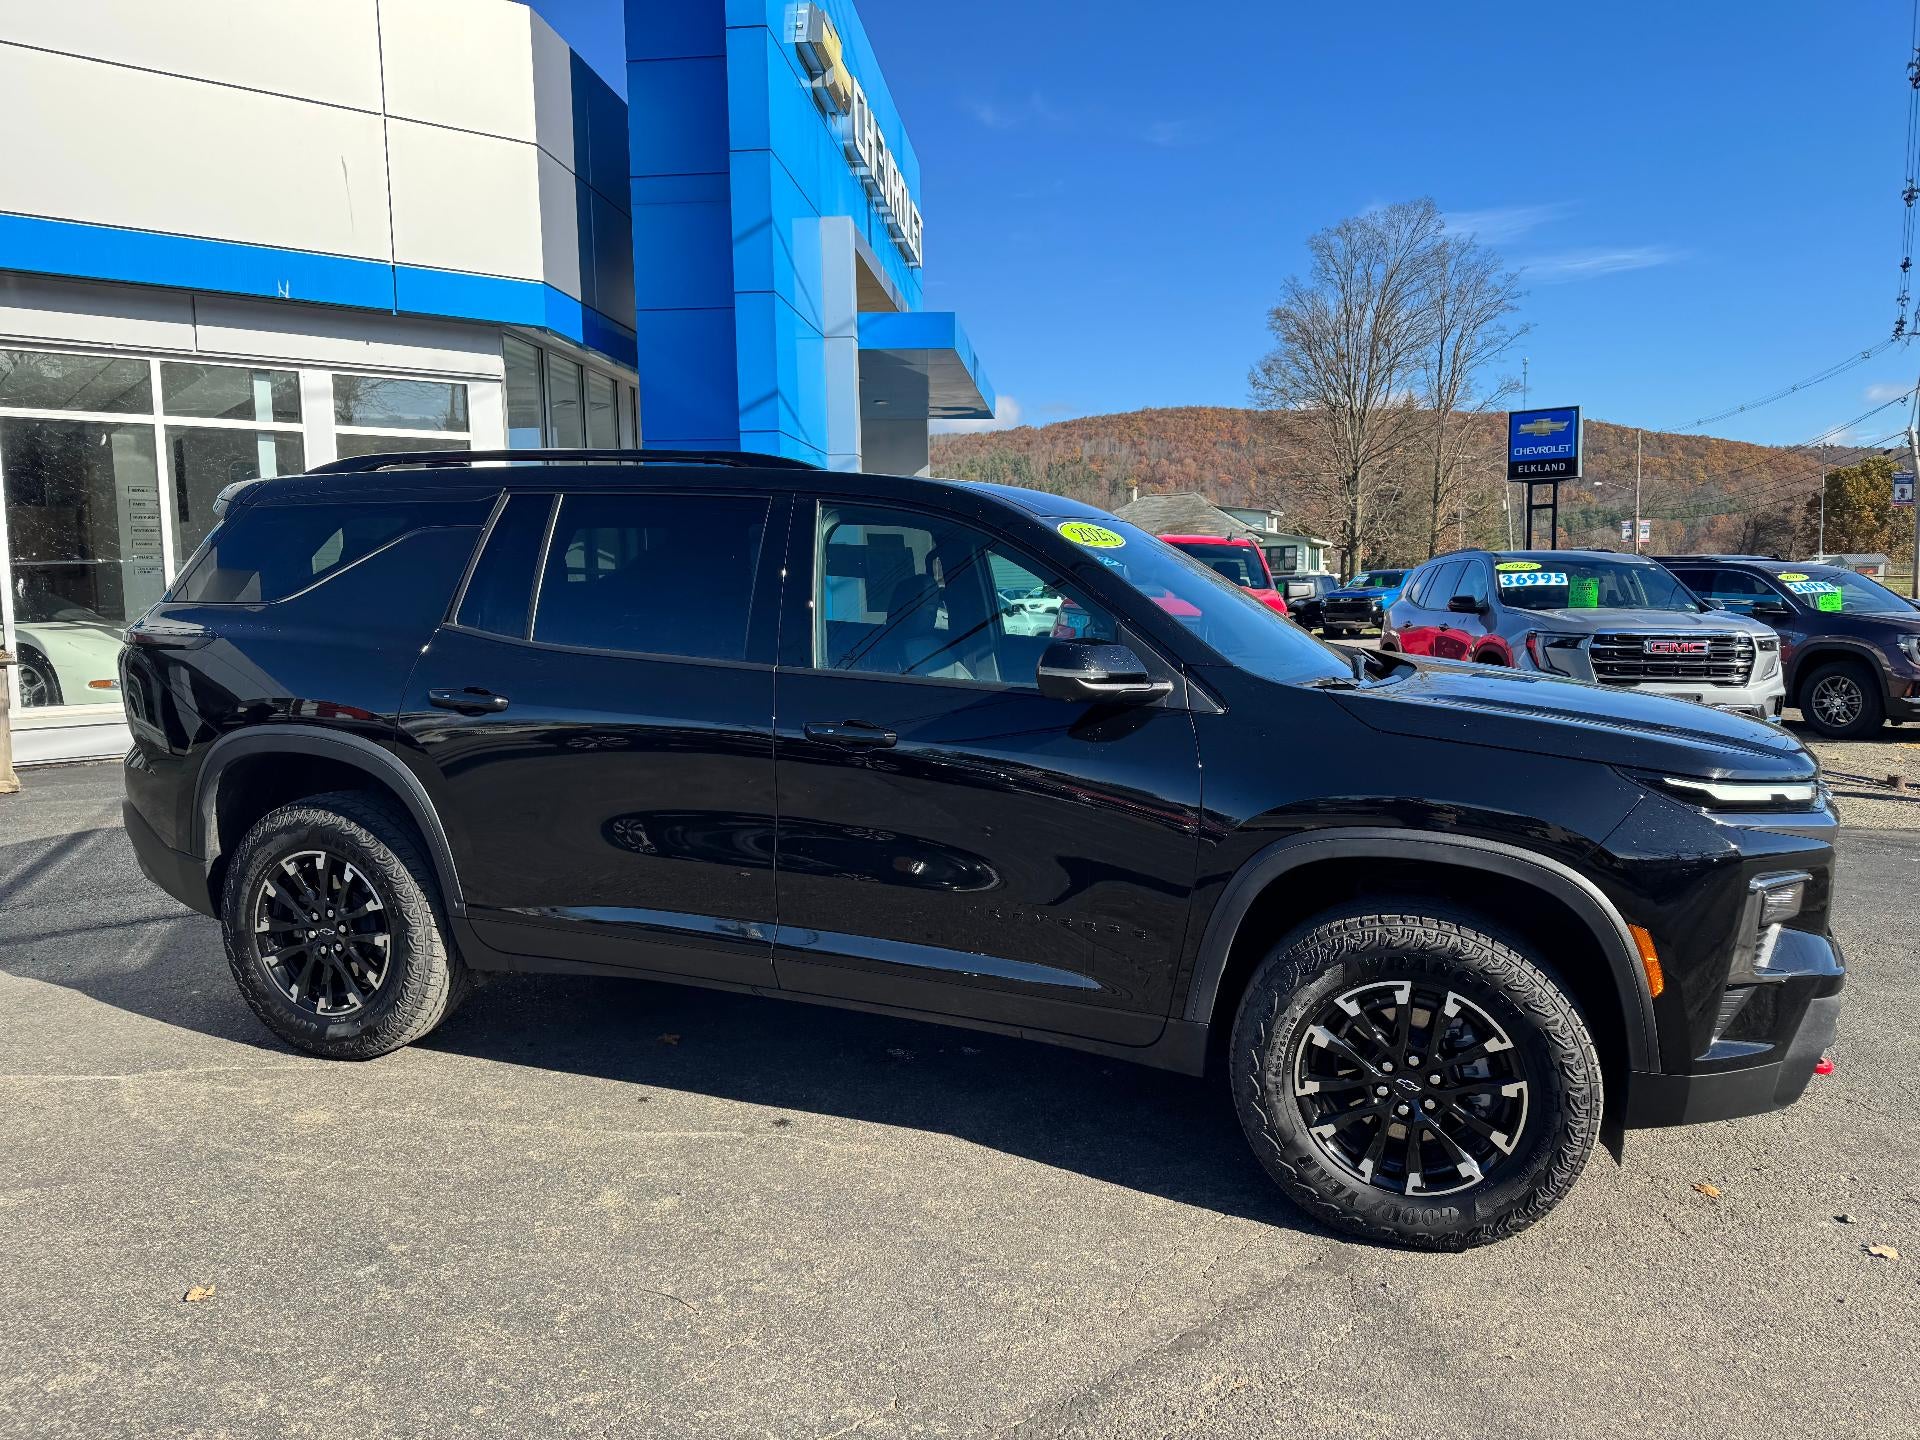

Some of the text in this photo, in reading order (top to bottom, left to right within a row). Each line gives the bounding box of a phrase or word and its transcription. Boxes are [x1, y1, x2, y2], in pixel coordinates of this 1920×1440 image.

[852, 76, 923, 268] CHEVROLET
[1514, 444, 1571, 456] CHEVROLET
[1518, 463, 1566, 473] ELKLAND
[1070, 527, 1117, 543] 2025
[1502, 573, 1565, 586] 36995
[1789, 582, 1836, 593] 36995
[1651, 642, 1708, 653] GMC
